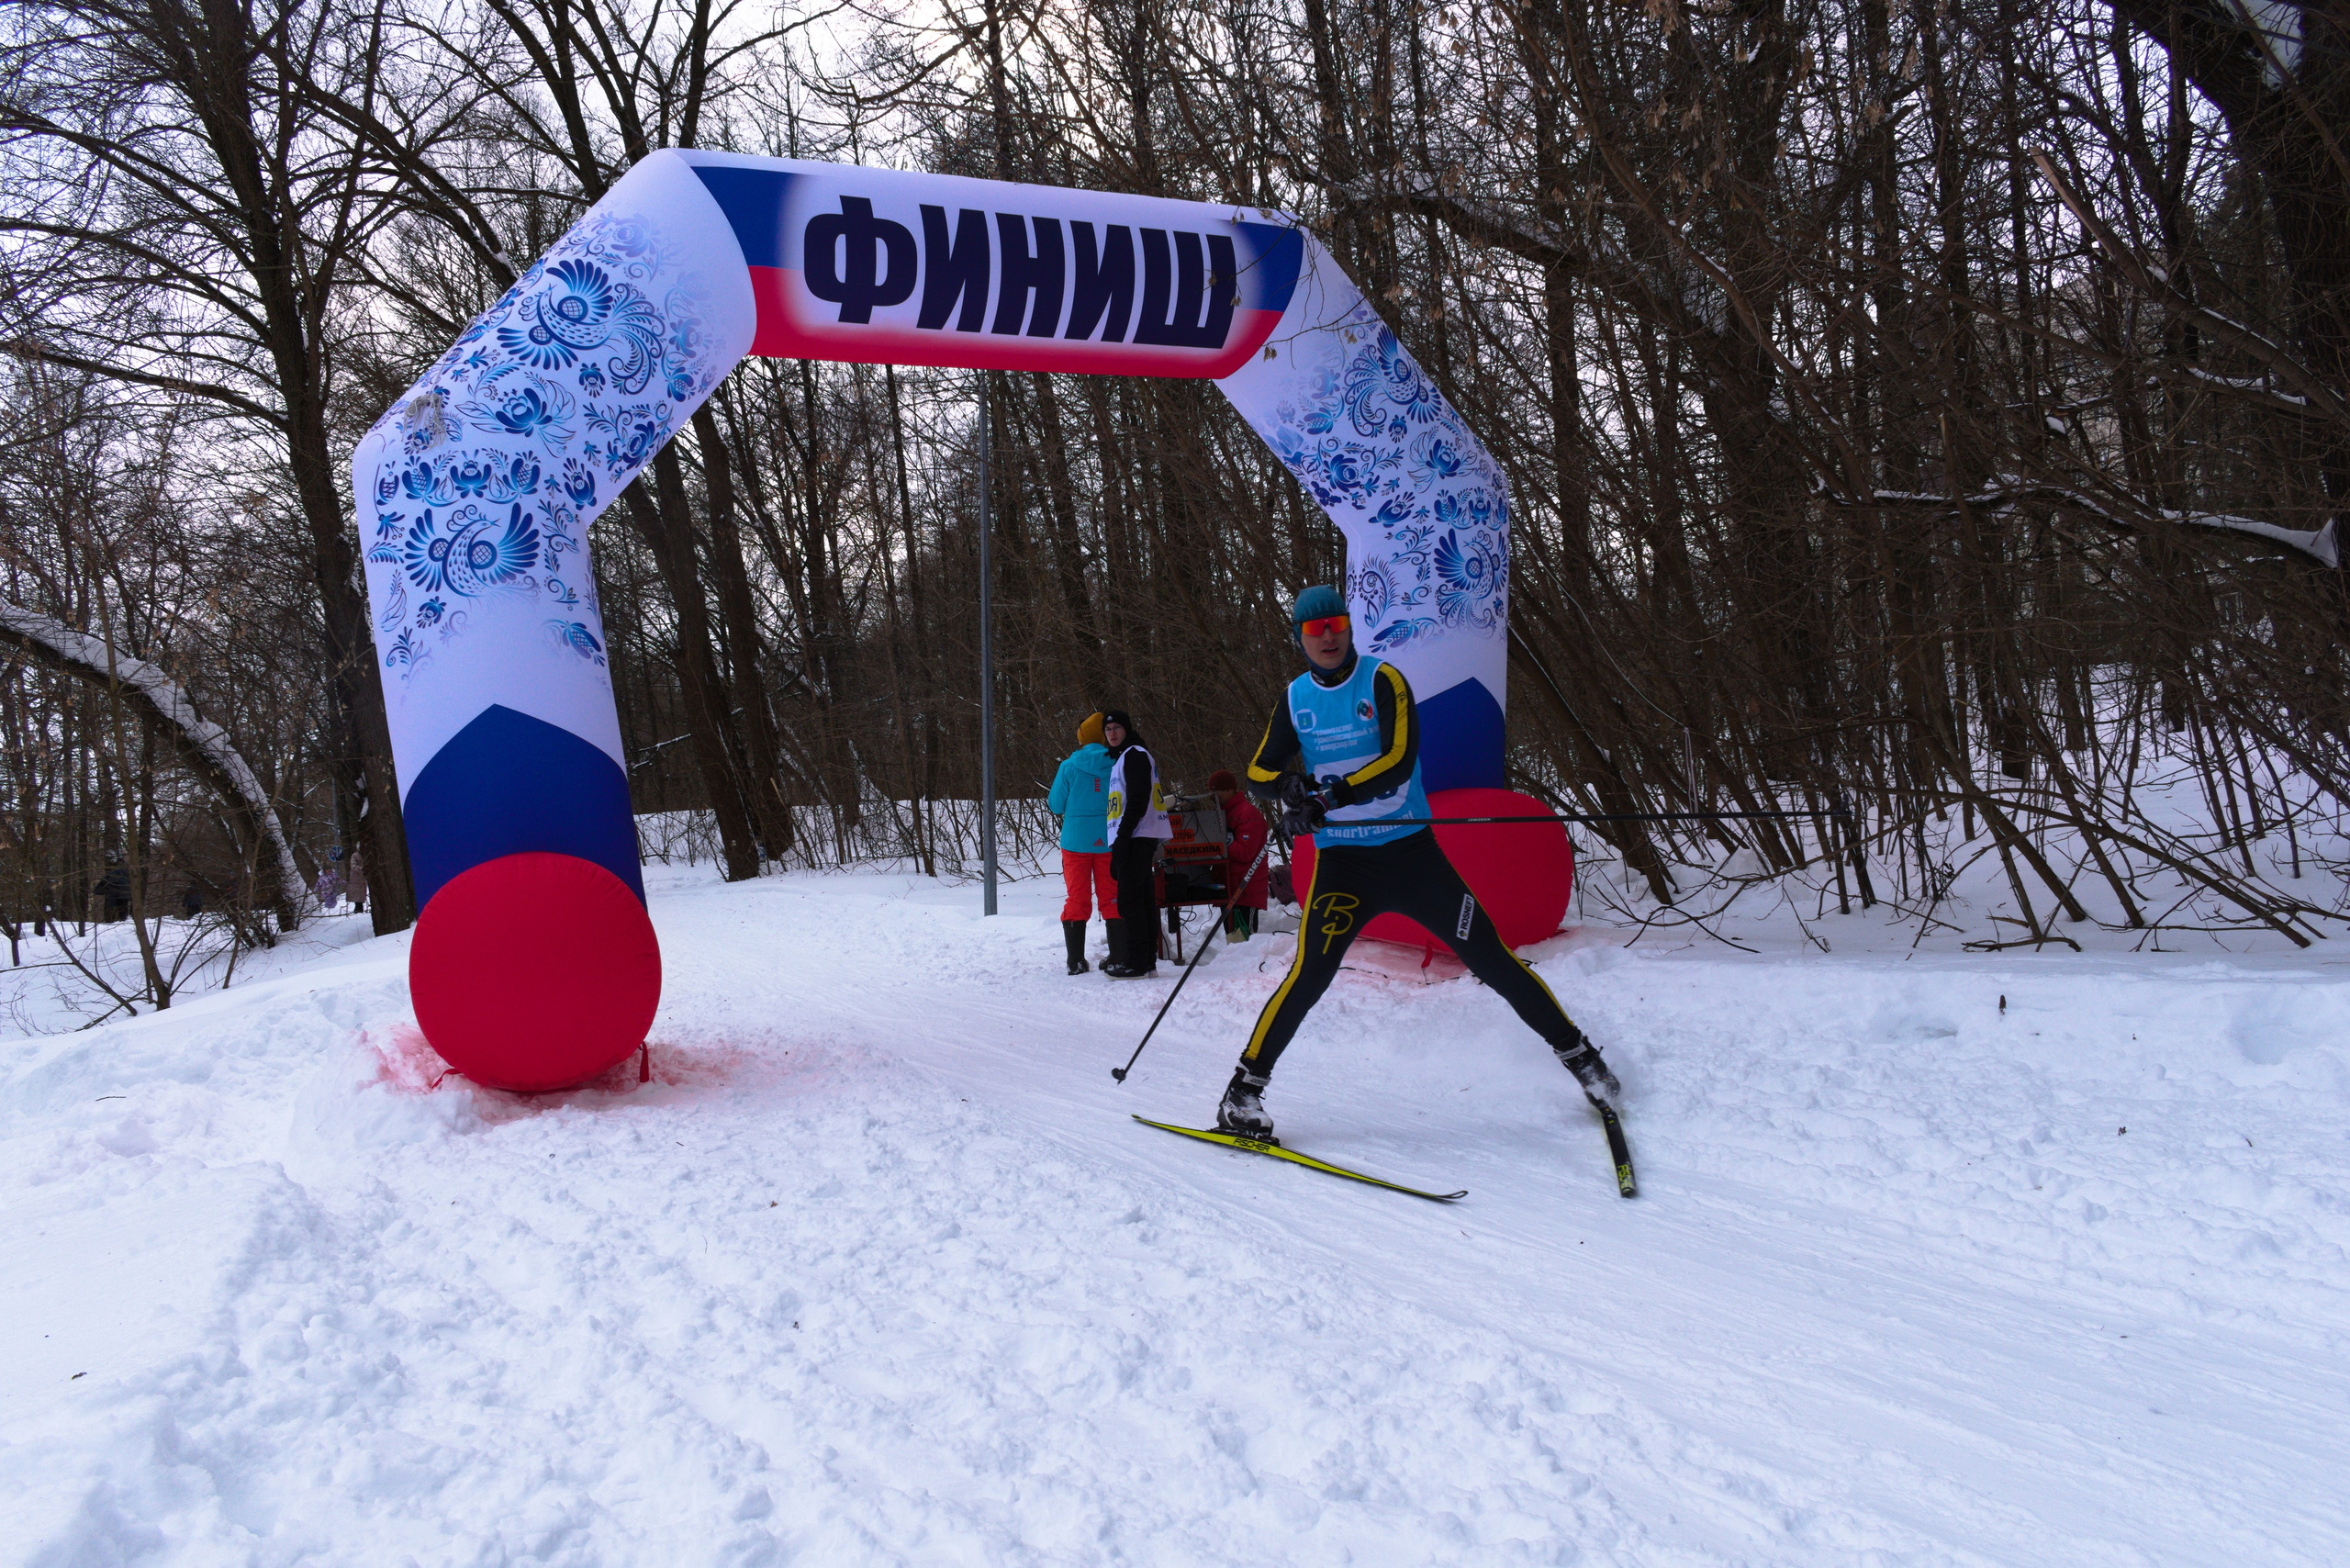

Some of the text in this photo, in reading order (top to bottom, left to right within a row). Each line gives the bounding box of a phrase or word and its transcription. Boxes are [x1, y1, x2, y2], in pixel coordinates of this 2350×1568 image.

[804, 195, 1237, 349] ФИНИШ
[1166, 846, 1221, 856] НАСЕДКИНА
[1460, 896, 1472, 930] ROSNEFT
[1234, 1137, 1270, 1152] FISCHER
